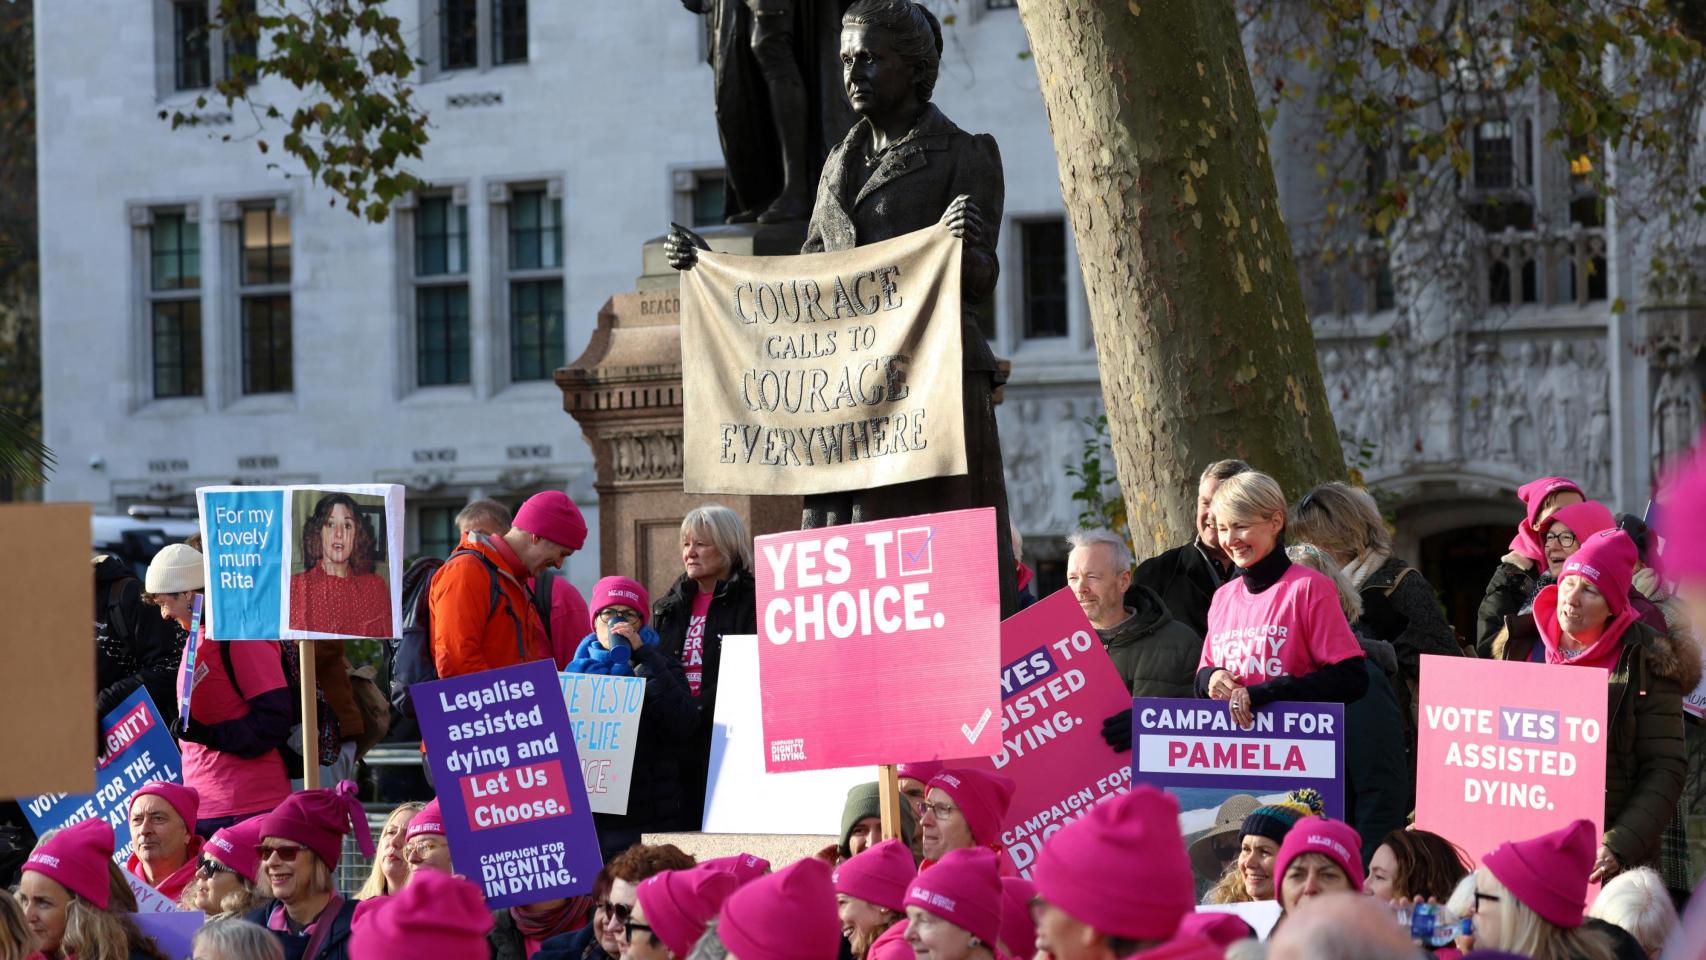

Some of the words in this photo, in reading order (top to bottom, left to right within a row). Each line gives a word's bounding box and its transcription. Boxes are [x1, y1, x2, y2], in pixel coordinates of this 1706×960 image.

[733, 265, 902, 325] COURAGE
[765, 329, 837, 359] CALLS
[848, 325, 876, 351] TO
[740, 354, 910, 414] COURAGE
[720, 408, 927, 467] EVERYWHERE
[216, 507, 244, 524] For
[248, 509, 273, 527] my
[218, 528, 268, 549] lovely
[219, 553, 261, 567] mum
[763, 537, 851, 591] YES
[220, 572, 254, 588] Rita
[764, 581, 945, 645] CHOICE.
[1001, 652, 1051, 693] YES
[1053, 630, 1092, 661] TO
[439, 680, 535, 712] Legalise
[591, 677, 618, 714] YES
[622, 677, 643, 714] TO
[448, 704, 543, 741] assisted
[1284, 712, 1335, 734] FOR
[1425, 705, 1493, 734] VOTE
[1502, 711, 1555, 740] YES
[1565, 716, 1600, 744] TO
[446, 745, 510, 774] dying
[517, 732, 559, 759] and
[771, 743, 804, 754] DIGNITY
[772, 753, 781, 762] IN
[781, 752, 807, 761] DYING.
[1168, 741, 1306, 771] PAMELA
[1444, 742, 1577, 777] ASSISTED
[96, 776, 127, 810] FOR
[123, 750, 156, 784] THE
[470, 772, 510, 798] Let
[515, 767, 547, 789] Us
[1464, 778, 1555, 810] DYING.
[474, 798, 565, 827] Choose.
[1001, 787, 1095, 845] CAMPAIGN
[1096, 766, 1132, 793] FOR
[480, 846, 539, 865] CAMPAIGN
[542, 841, 565, 854] FOR
[482, 852, 566, 882] DIGNITY
[129, 880, 154, 903] MY
[485, 879, 507, 898] IN
[509, 868, 577, 894] DYING.
